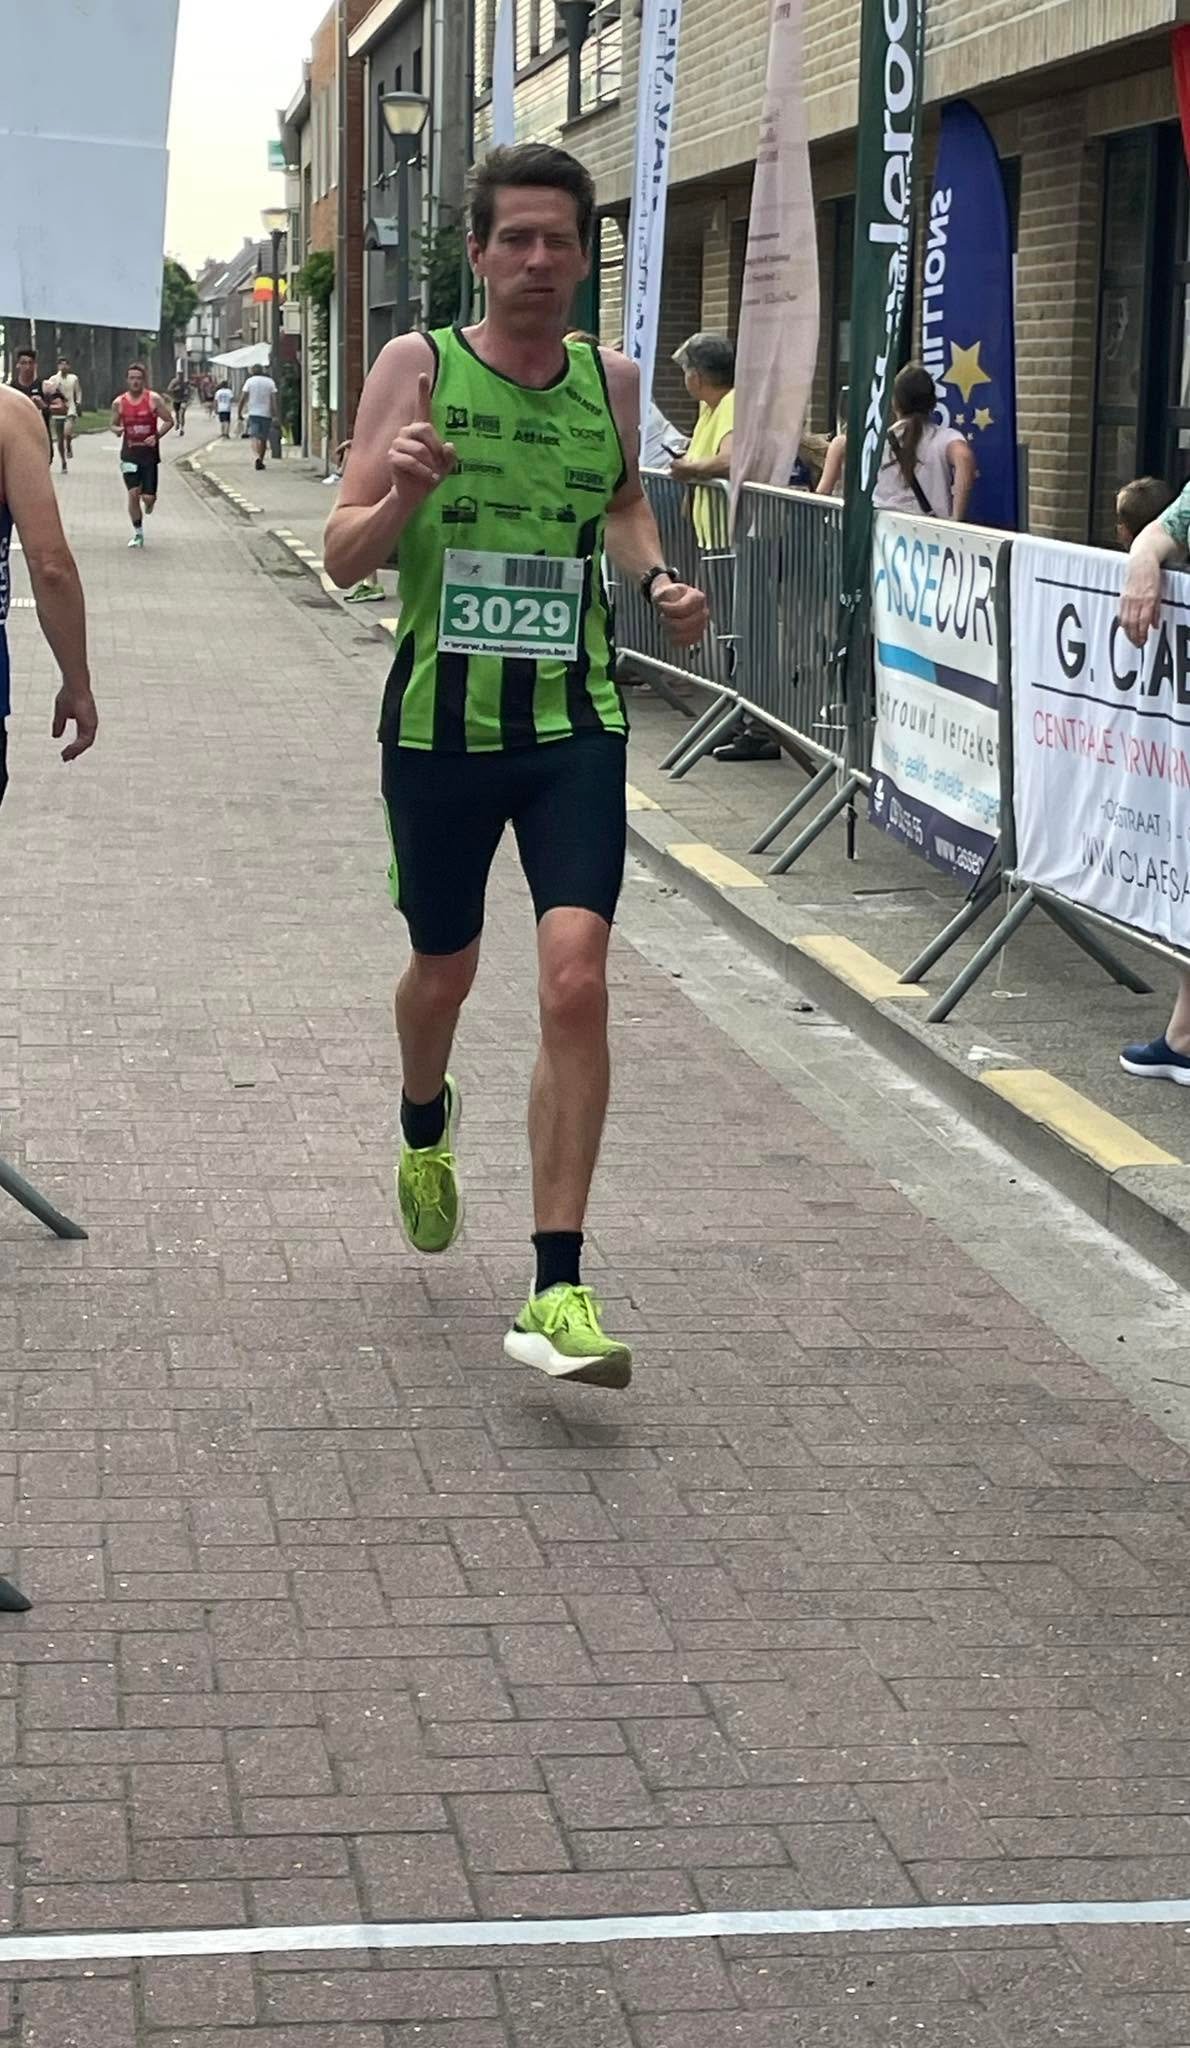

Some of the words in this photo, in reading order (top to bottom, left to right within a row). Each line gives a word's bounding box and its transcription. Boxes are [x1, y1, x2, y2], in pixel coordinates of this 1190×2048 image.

[450, 593, 571, 638] 3029
[1056, 603, 1095, 683] G.
[1032, 710, 1116, 765] CENTRALE
